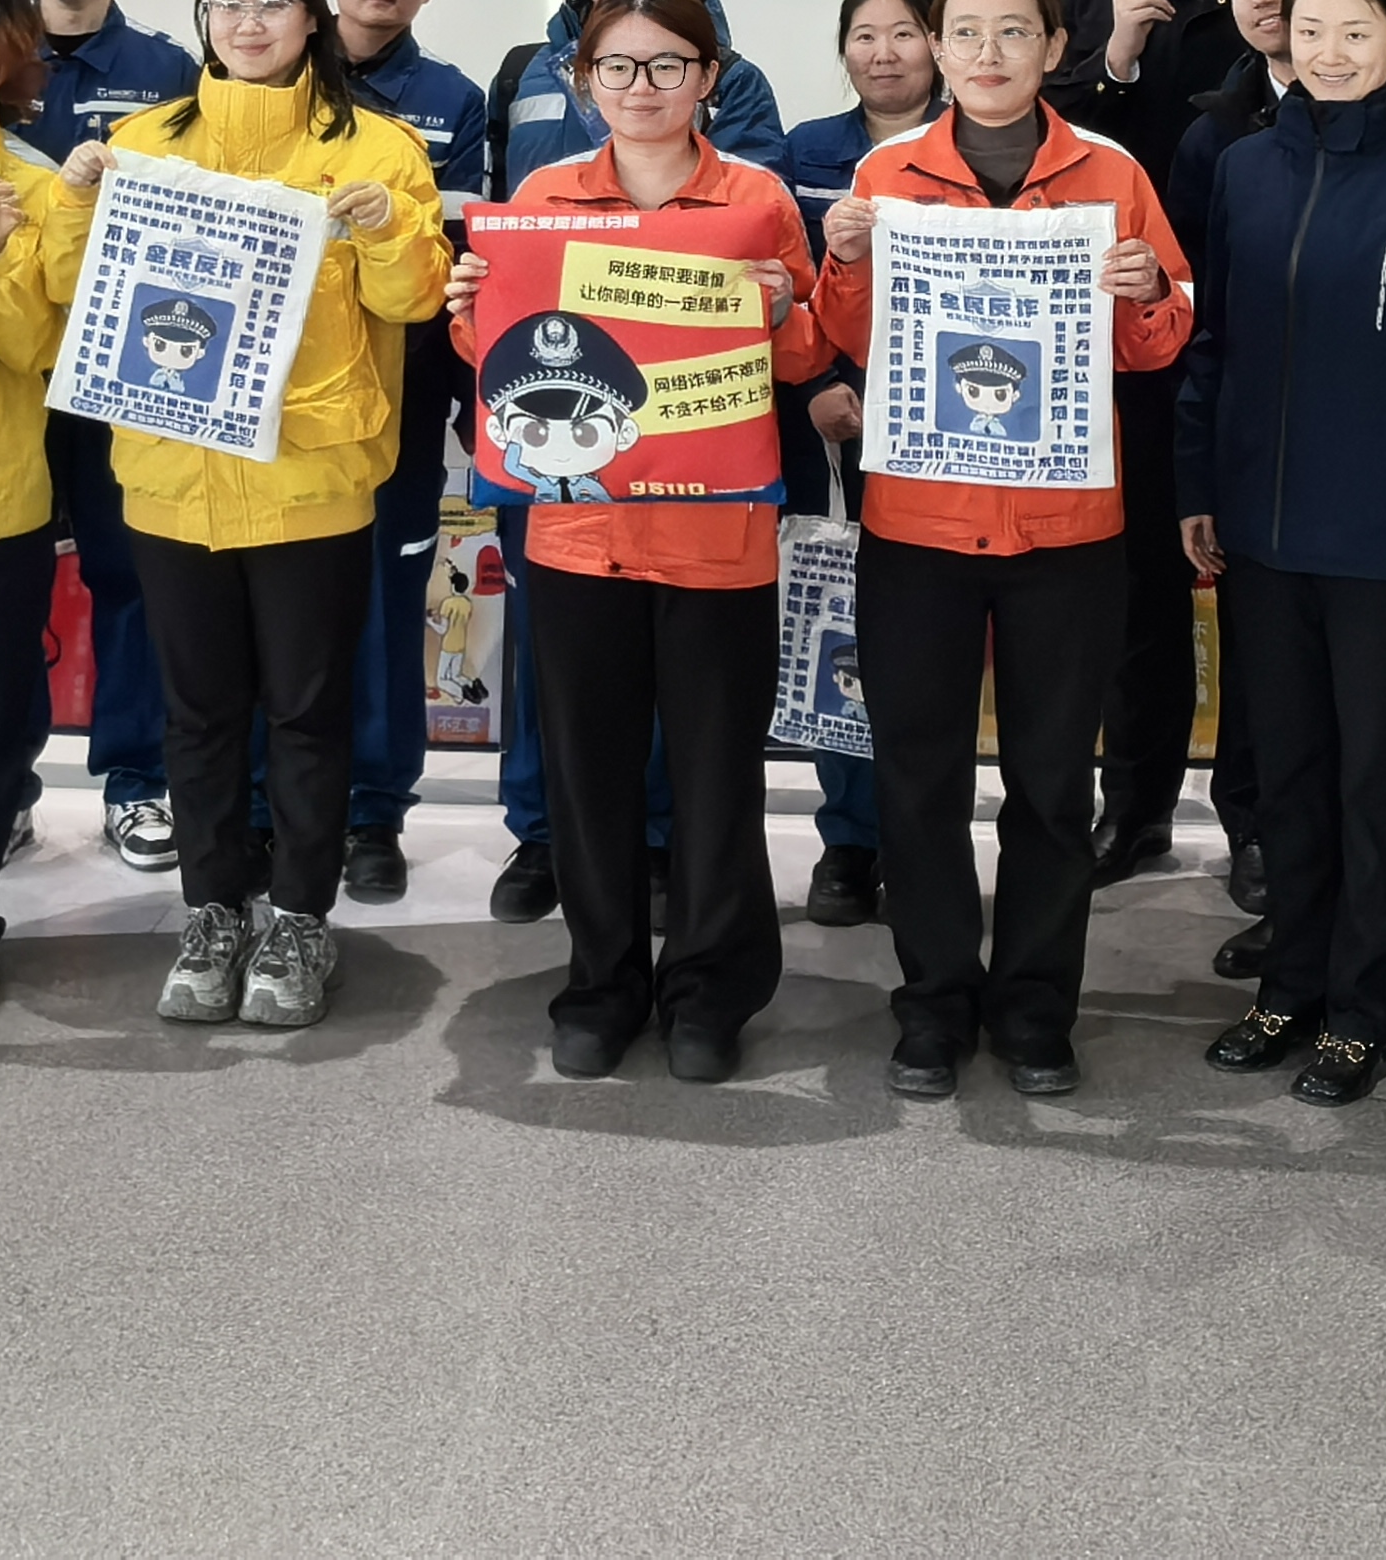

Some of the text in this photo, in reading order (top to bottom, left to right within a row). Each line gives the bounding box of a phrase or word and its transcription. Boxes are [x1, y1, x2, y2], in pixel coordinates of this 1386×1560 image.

[608, 259, 726, 289] 网络兼职要谨慎
[580, 281, 743, 314] 让你刷单的一定是骗子
[940, 292, 1040, 319] 全民反诈
